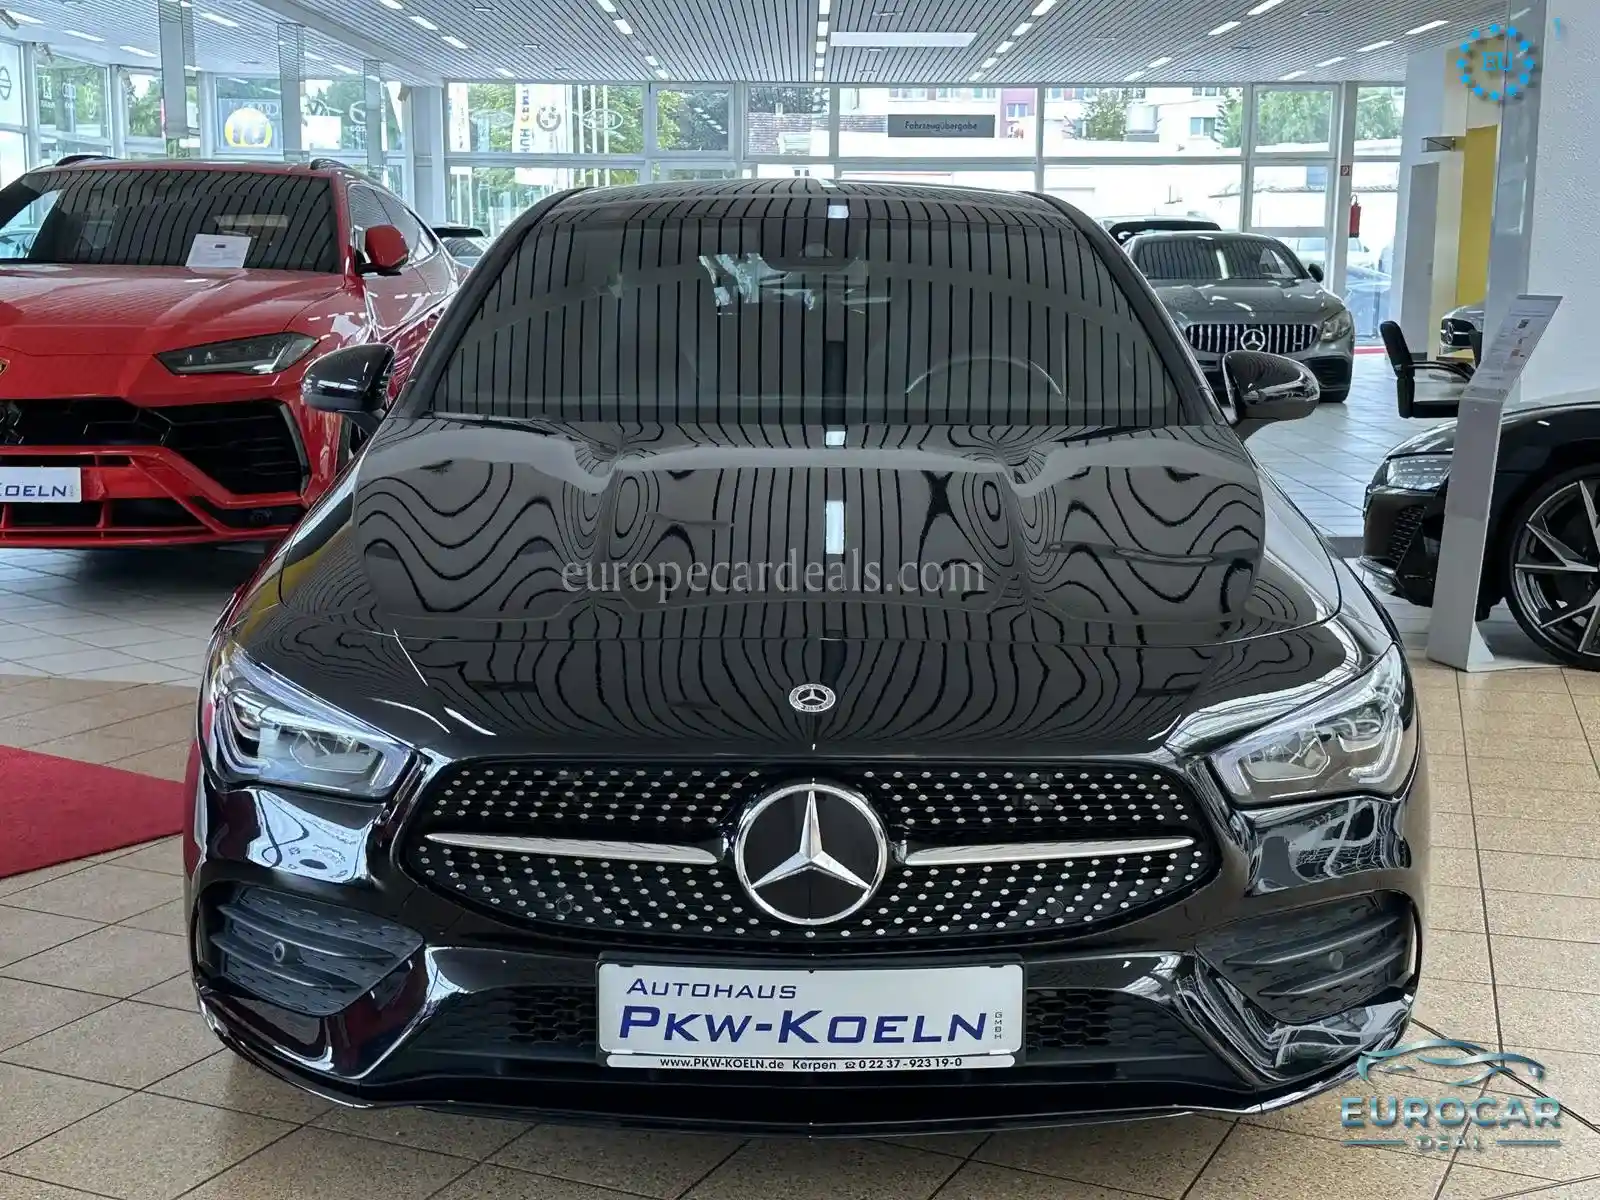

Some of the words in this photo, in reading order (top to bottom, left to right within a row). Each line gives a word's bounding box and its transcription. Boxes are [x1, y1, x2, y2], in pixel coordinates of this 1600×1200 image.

[904, 120, 977, 132] Fahrzeugübergabe
[0, 483, 67, 497] OELN
[626, 978, 797, 999] AUTOHAUS
[618, 1005, 988, 1044] PKW-KOELN
[660, 1057, 785, 1070] www.PKW-KOELN.de
[792, 1059, 837, 1071] Kerpen
